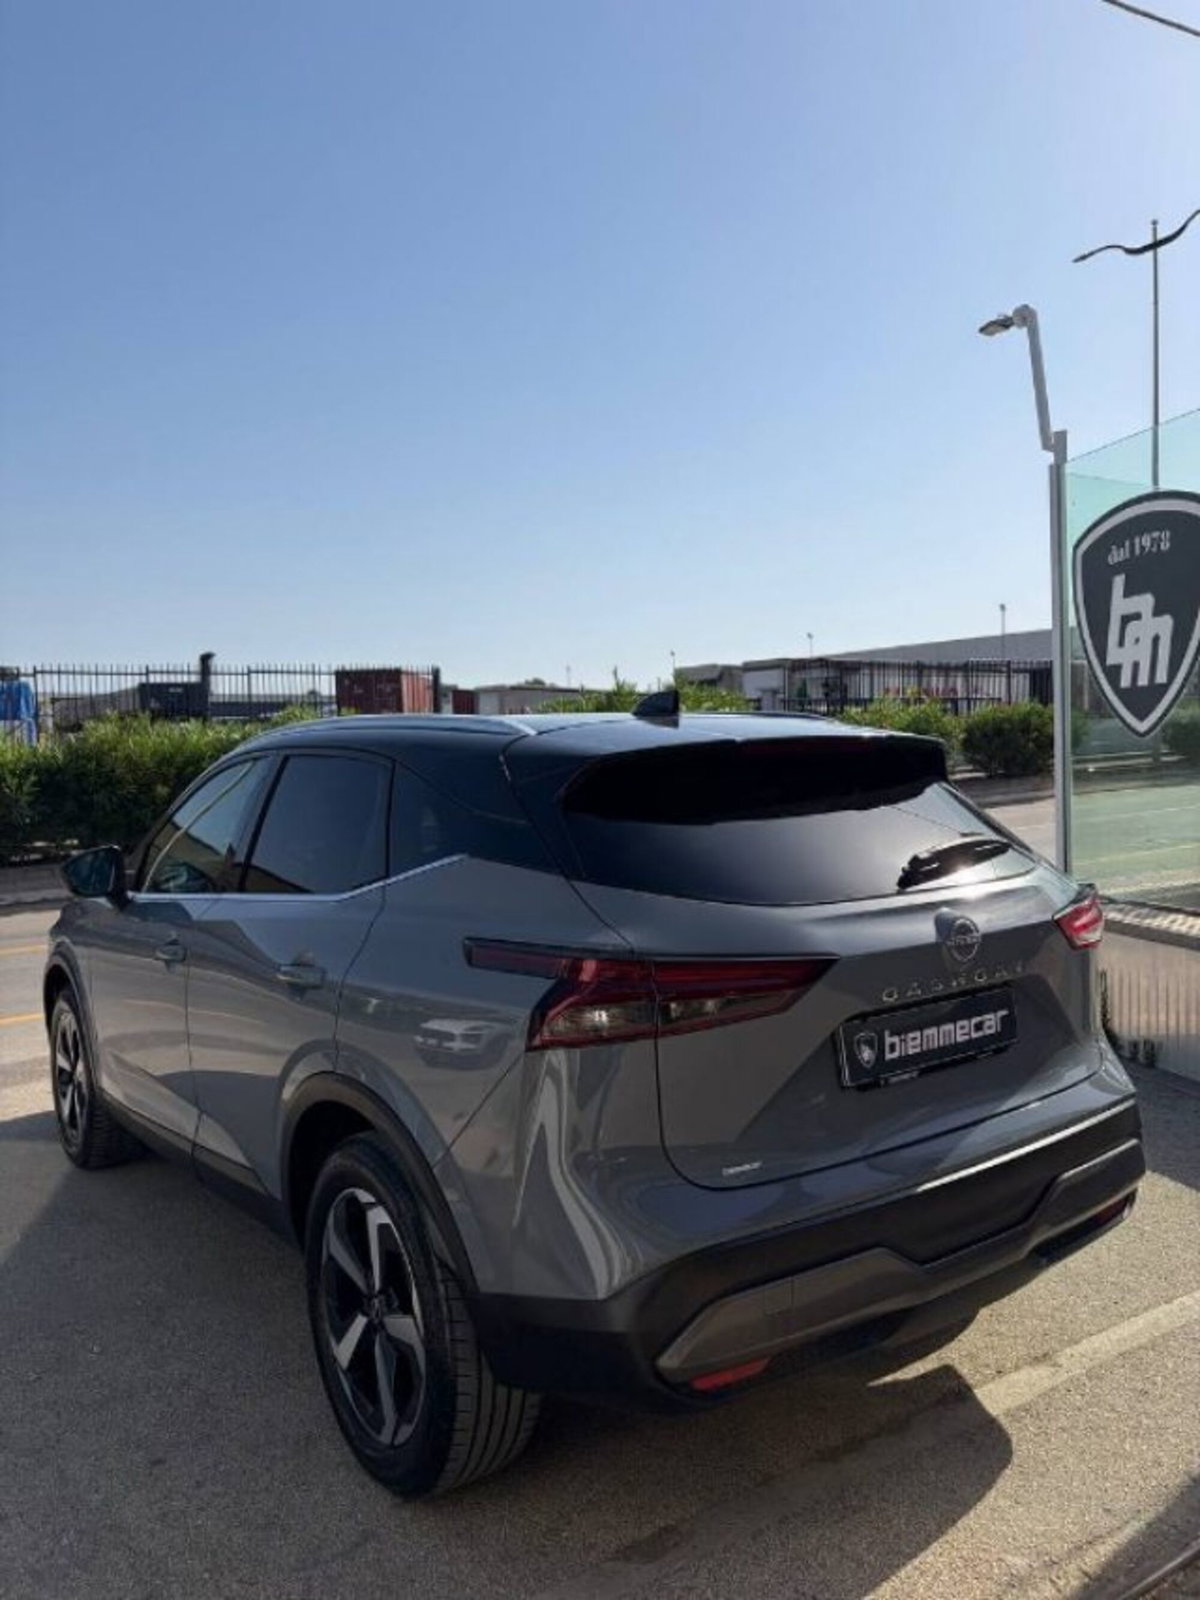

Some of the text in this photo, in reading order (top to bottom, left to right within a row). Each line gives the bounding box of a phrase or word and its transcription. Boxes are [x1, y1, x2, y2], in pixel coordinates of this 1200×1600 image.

[1107, 530, 1170, 565] dal 1978
[884, 1009, 1009, 1061] biemmecar
